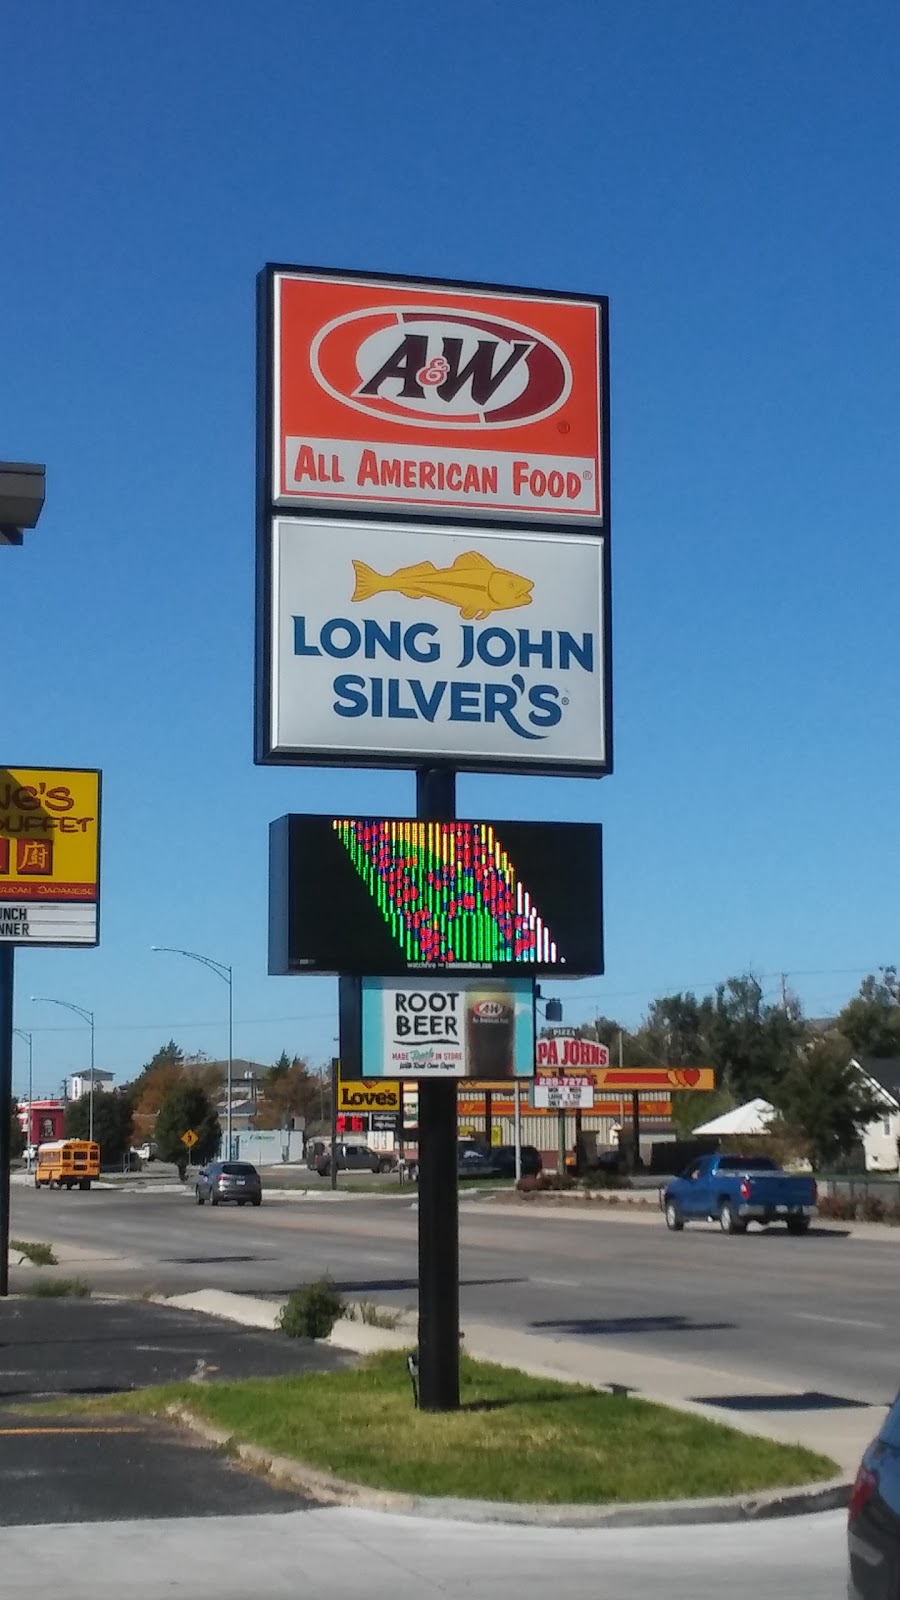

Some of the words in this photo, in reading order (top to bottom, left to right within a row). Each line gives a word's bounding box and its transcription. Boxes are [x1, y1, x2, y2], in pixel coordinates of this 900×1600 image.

[358, 333, 538, 406] A&W
[357, 448, 498, 494] AMERICAN
[290, 615, 441, 663] LONG
[456, 624, 594, 673] JOHN
[332, 673, 563, 740] SILVER'S
[395, 993, 460, 1012] ROOT
[396, 1015, 458, 1037] BEER
[392, 1053, 410, 1061] MADE
[537, 1041, 558, 1065] PA
[561, 1040, 607, 1065] JOHNS
[341, 1087, 397, 1106] Love's
